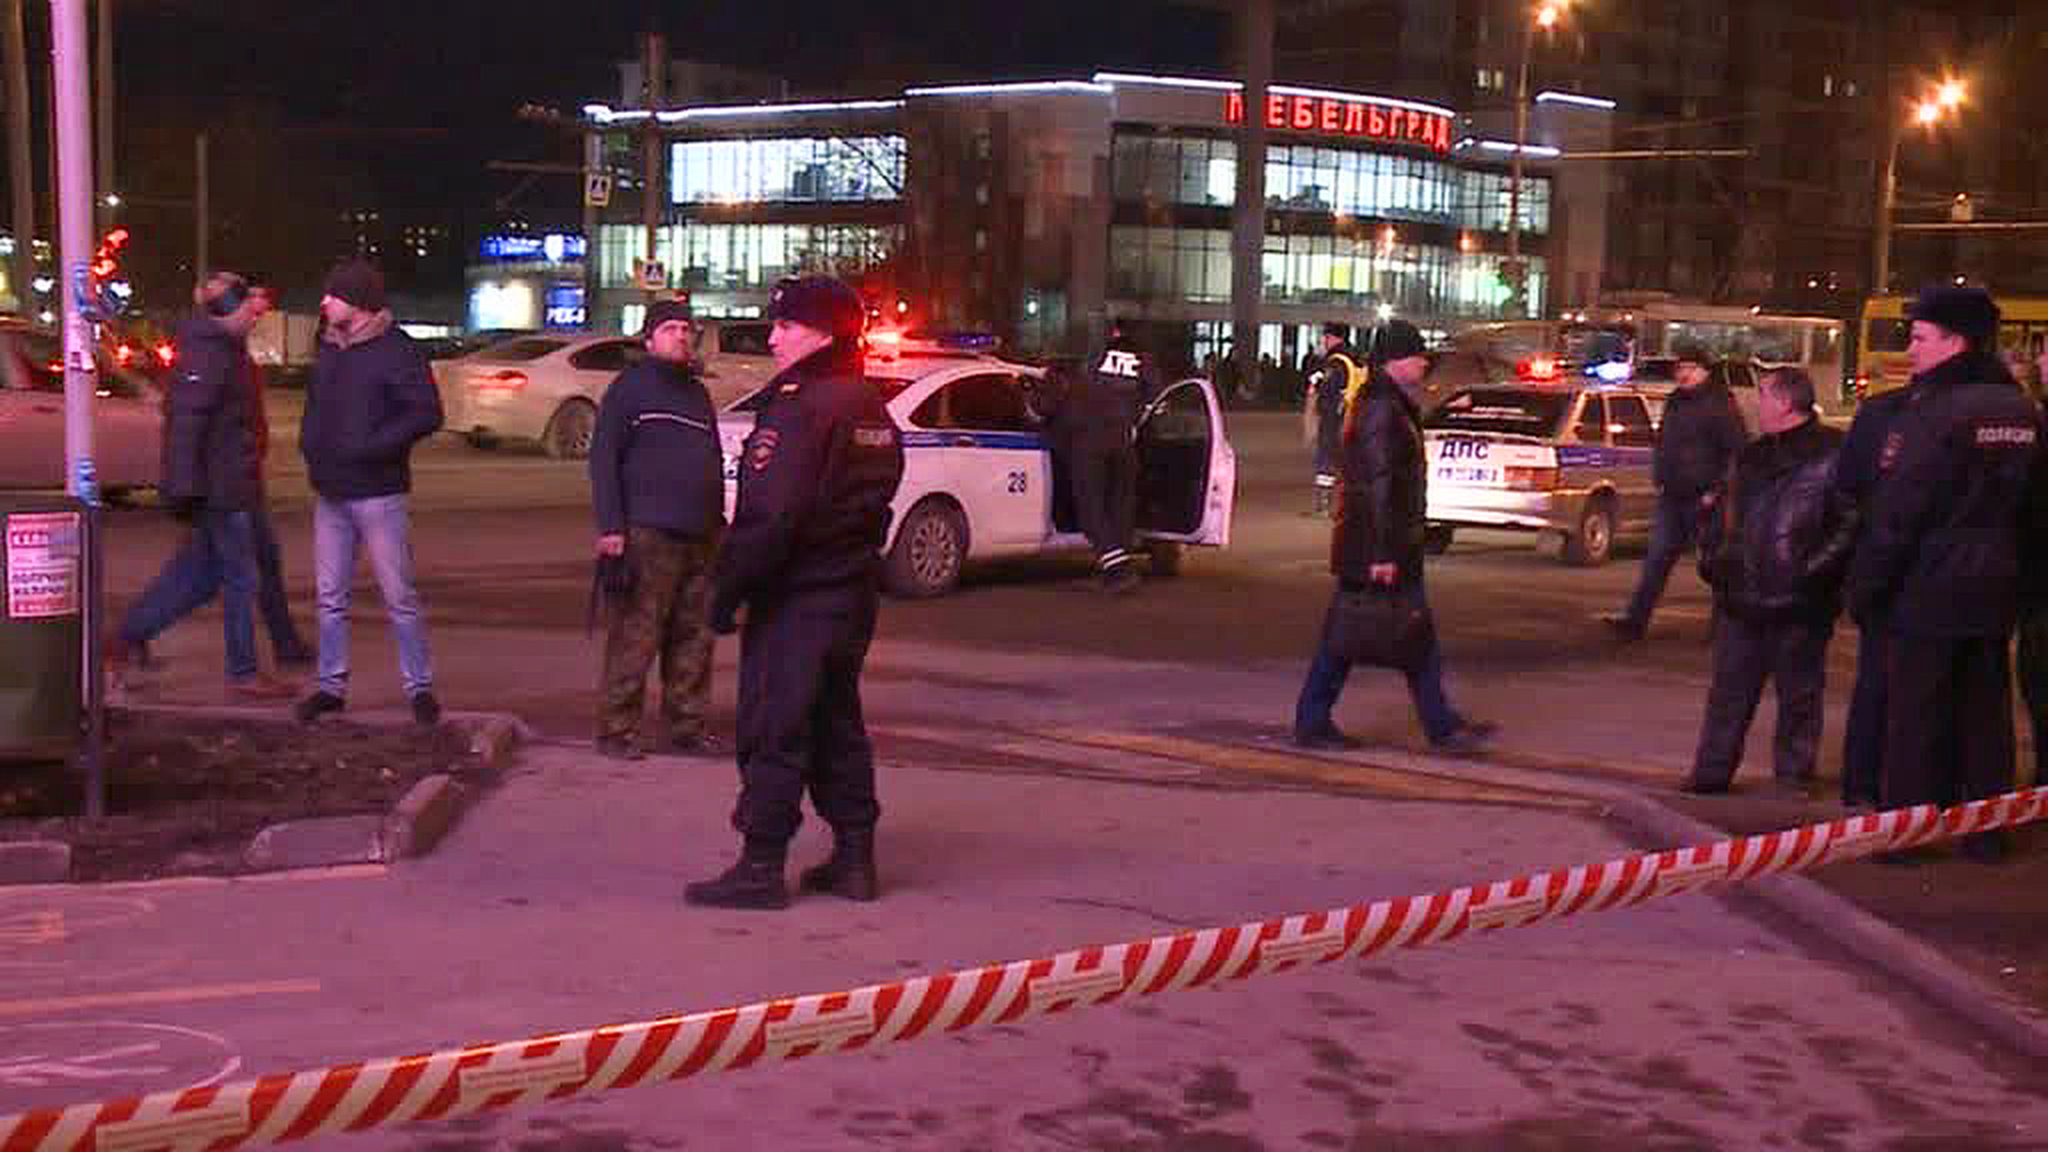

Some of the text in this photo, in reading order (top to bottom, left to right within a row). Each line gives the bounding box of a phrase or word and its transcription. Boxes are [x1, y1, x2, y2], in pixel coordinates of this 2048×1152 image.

[1099, 350, 1141, 377] ДПС
[1440, 440, 1489, 460] ДПС
[1008, 471, 1027, 493] 28
